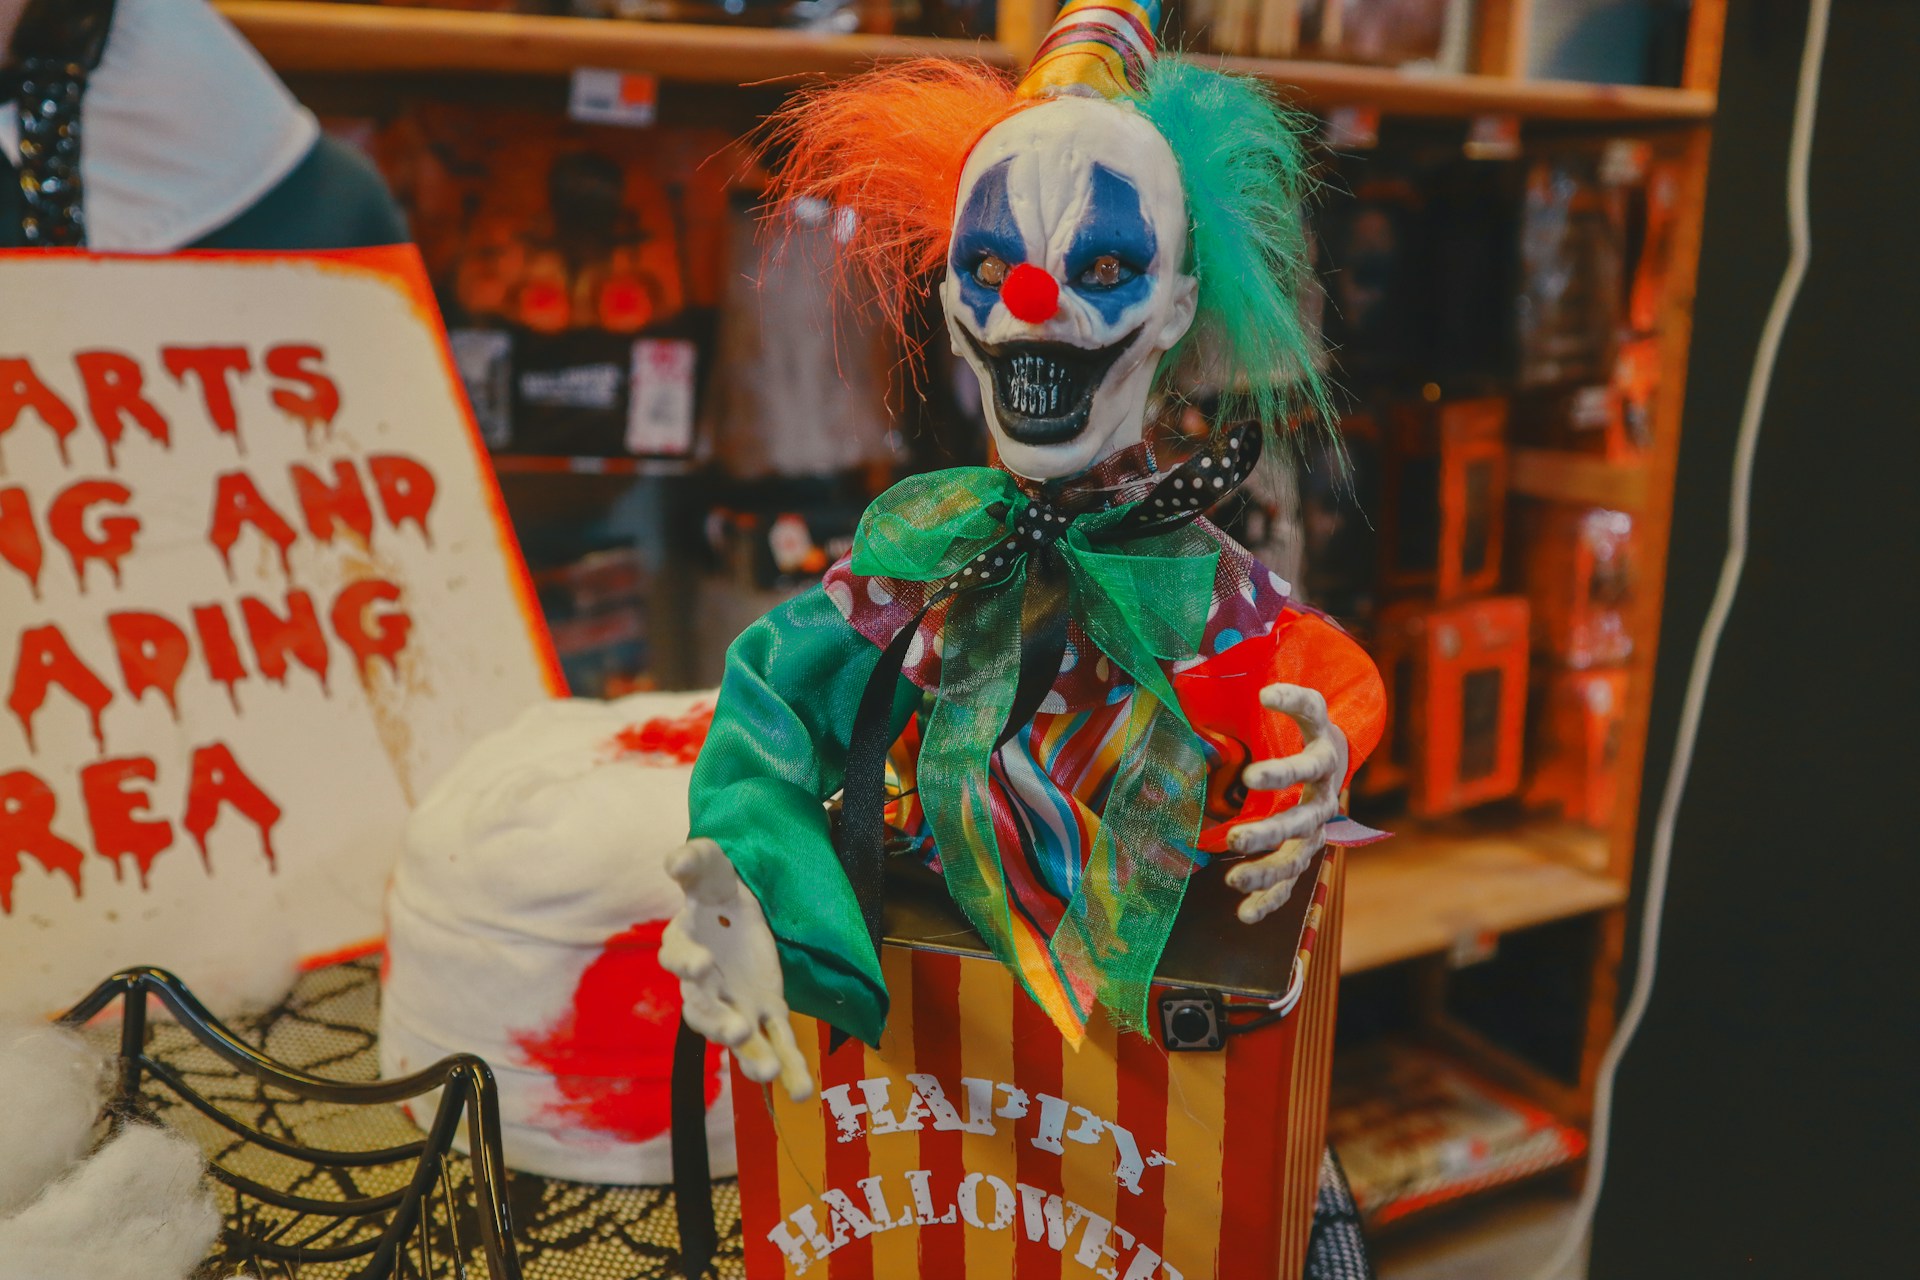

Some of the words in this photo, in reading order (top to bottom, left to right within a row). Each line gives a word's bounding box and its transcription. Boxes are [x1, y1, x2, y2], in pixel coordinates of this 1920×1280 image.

[208, 453, 437, 582] AND
[7, 576, 413, 754] ADING
[0, 742, 282, 915] REA
[821, 1073, 1176, 1196] HAPPY
